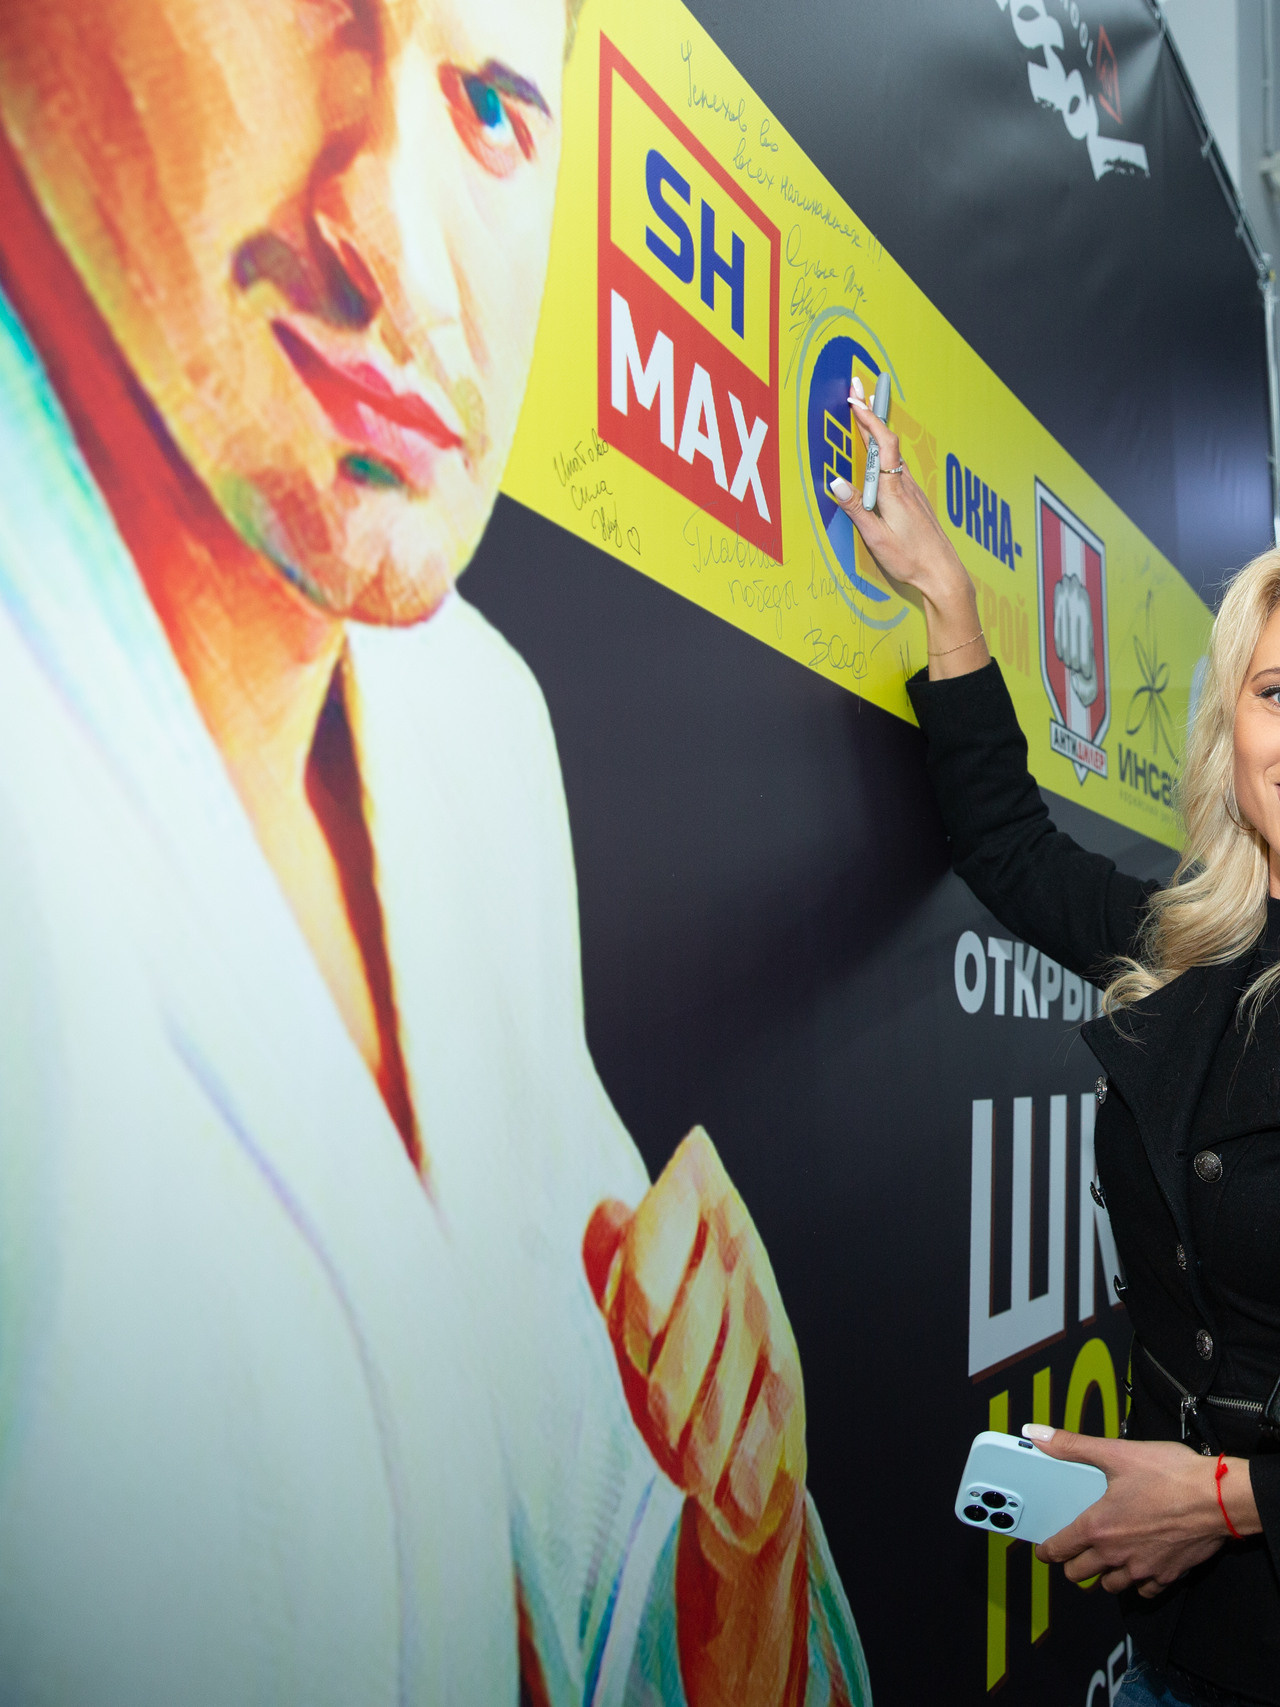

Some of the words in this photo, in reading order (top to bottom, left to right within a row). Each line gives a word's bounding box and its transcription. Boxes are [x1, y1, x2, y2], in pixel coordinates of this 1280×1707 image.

[645, 148, 745, 340] SH
[611, 287, 772, 525] MAX
[946, 452, 1023, 572] ОКНА-
[954, 930, 1108, 1022] ОТКРЫ
